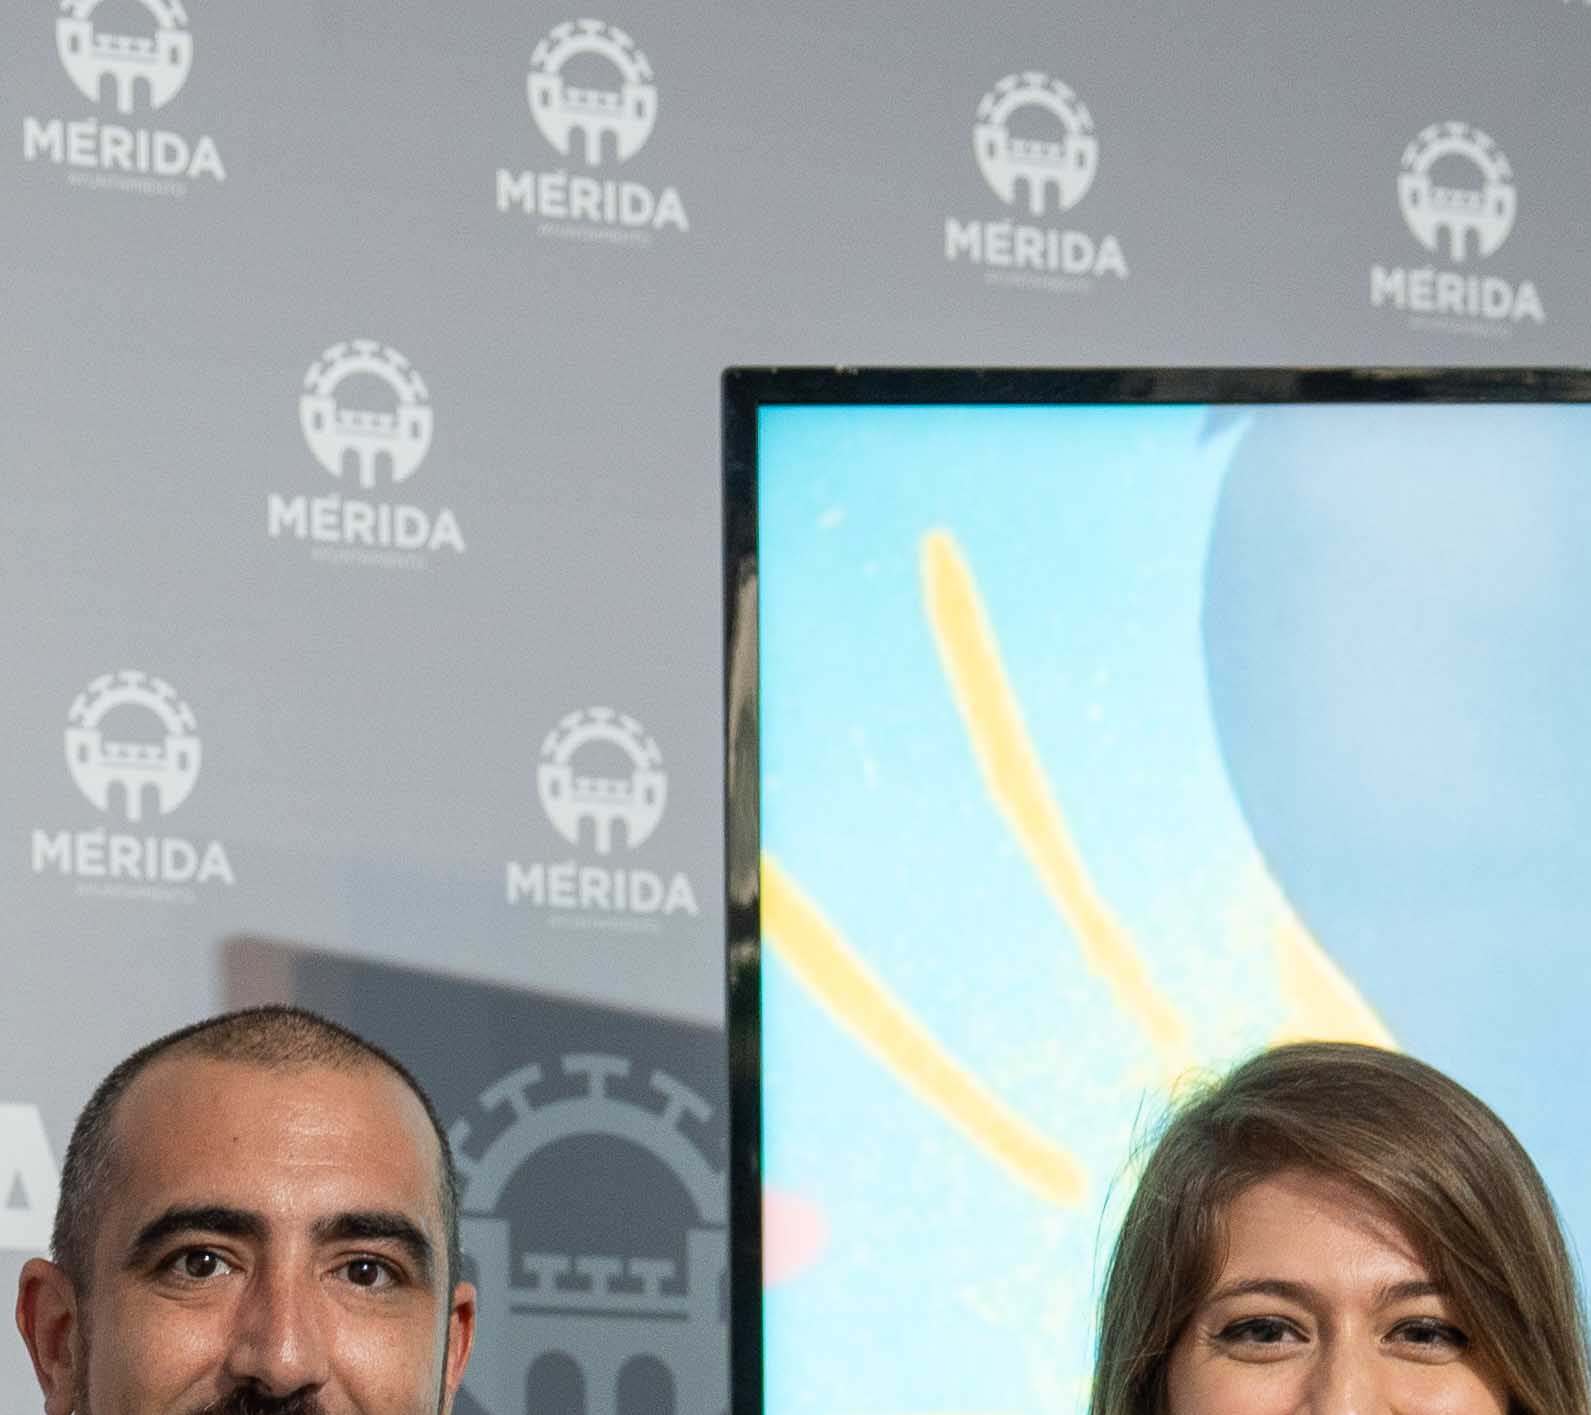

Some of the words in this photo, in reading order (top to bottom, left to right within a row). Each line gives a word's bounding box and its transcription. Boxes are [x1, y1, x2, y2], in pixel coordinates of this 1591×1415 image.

[24, 118, 225, 180] MÉRIDA
[497, 170, 689, 230] MÉRIDA
[946, 219, 1127, 277] MÉRIDA
[1371, 266, 1544, 322] MÉRIDA
[269, 494, 464, 552] MÉRIDA
[33, 829, 234, 884] MÉRIDA
[507, 861, 698, 915] MÉRIDA
